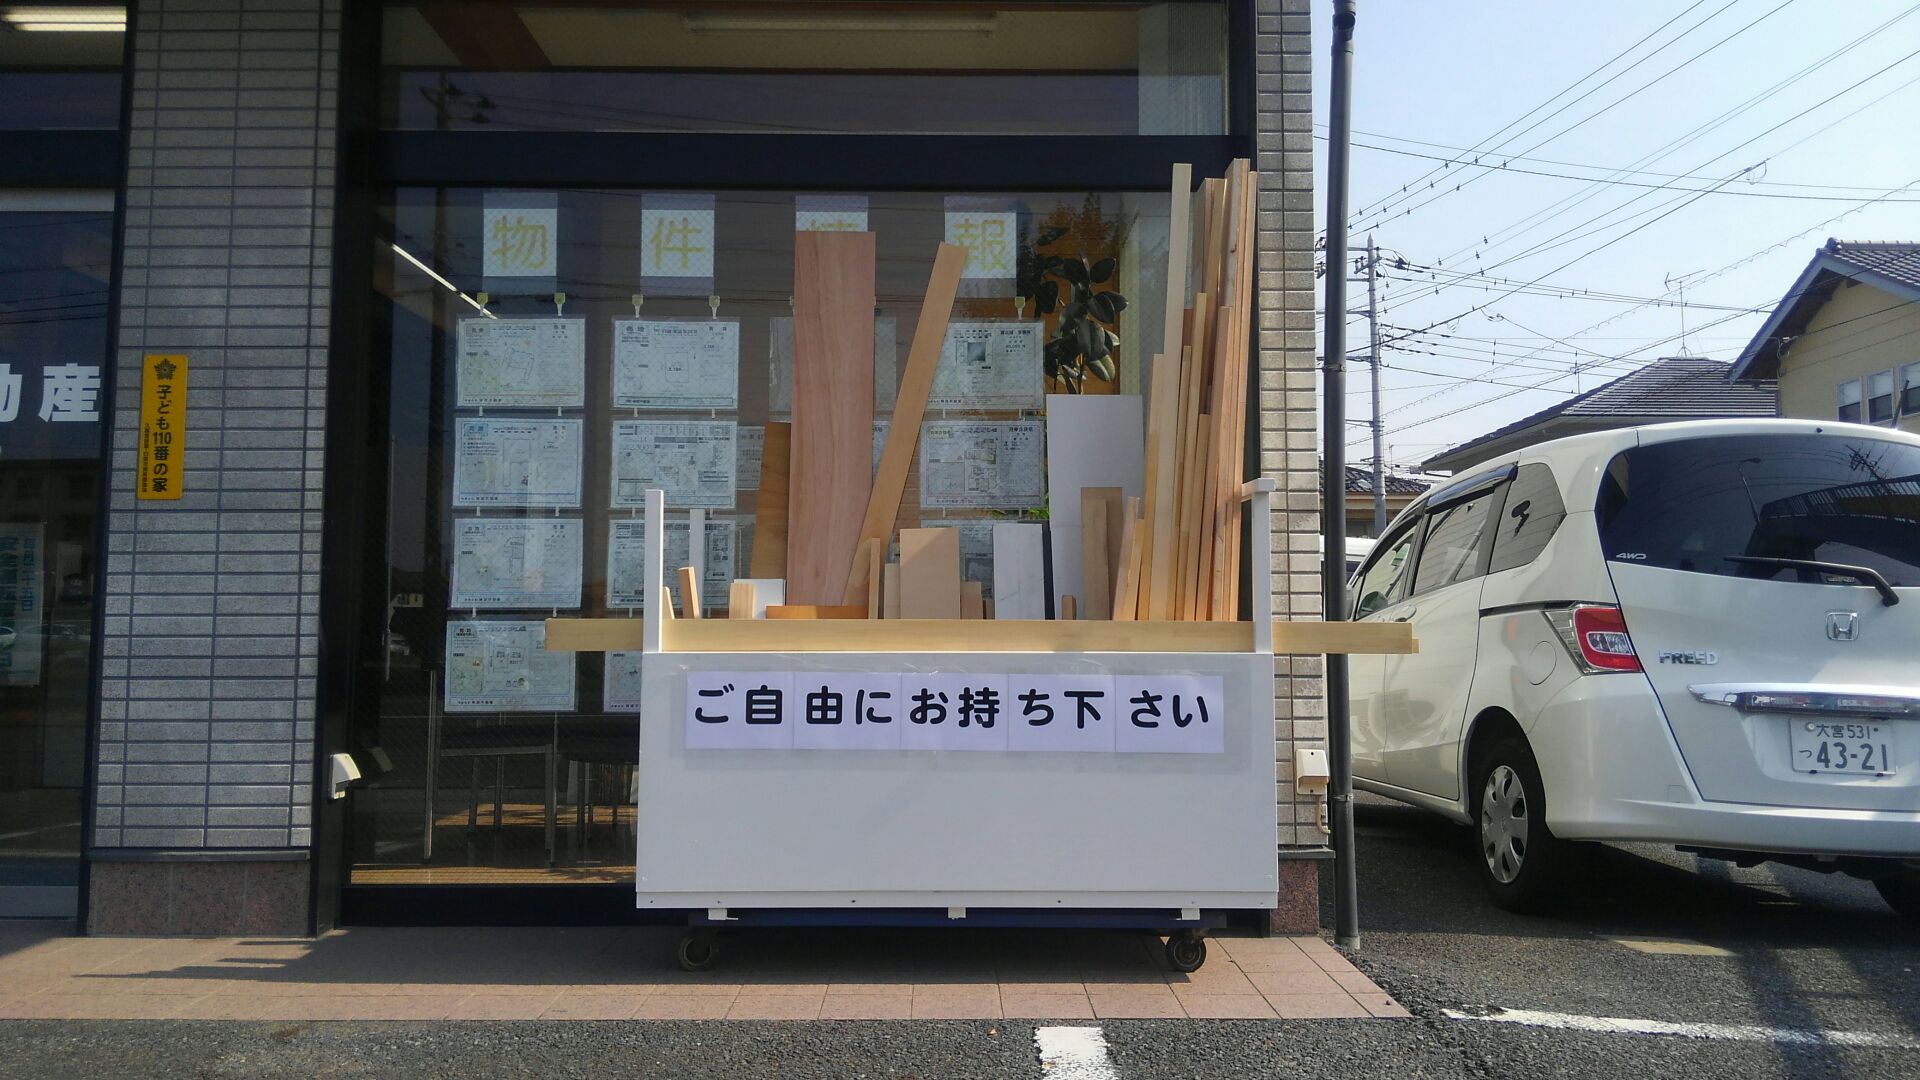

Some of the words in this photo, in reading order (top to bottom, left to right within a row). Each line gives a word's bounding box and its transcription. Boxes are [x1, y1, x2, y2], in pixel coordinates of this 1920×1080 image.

[492, 215, 549, 270] 物
[650, 216, 705, 270] 件
[152, 384, 172, 493] 子ども110番の家
[1616, 552, 1647, 560] 4WD
[1659, 651, 1719, 665] FREED
[695, 683, 1208, 729] ご自由にお持ち下さい
[1817, 741, 1888, 771] 43-21
